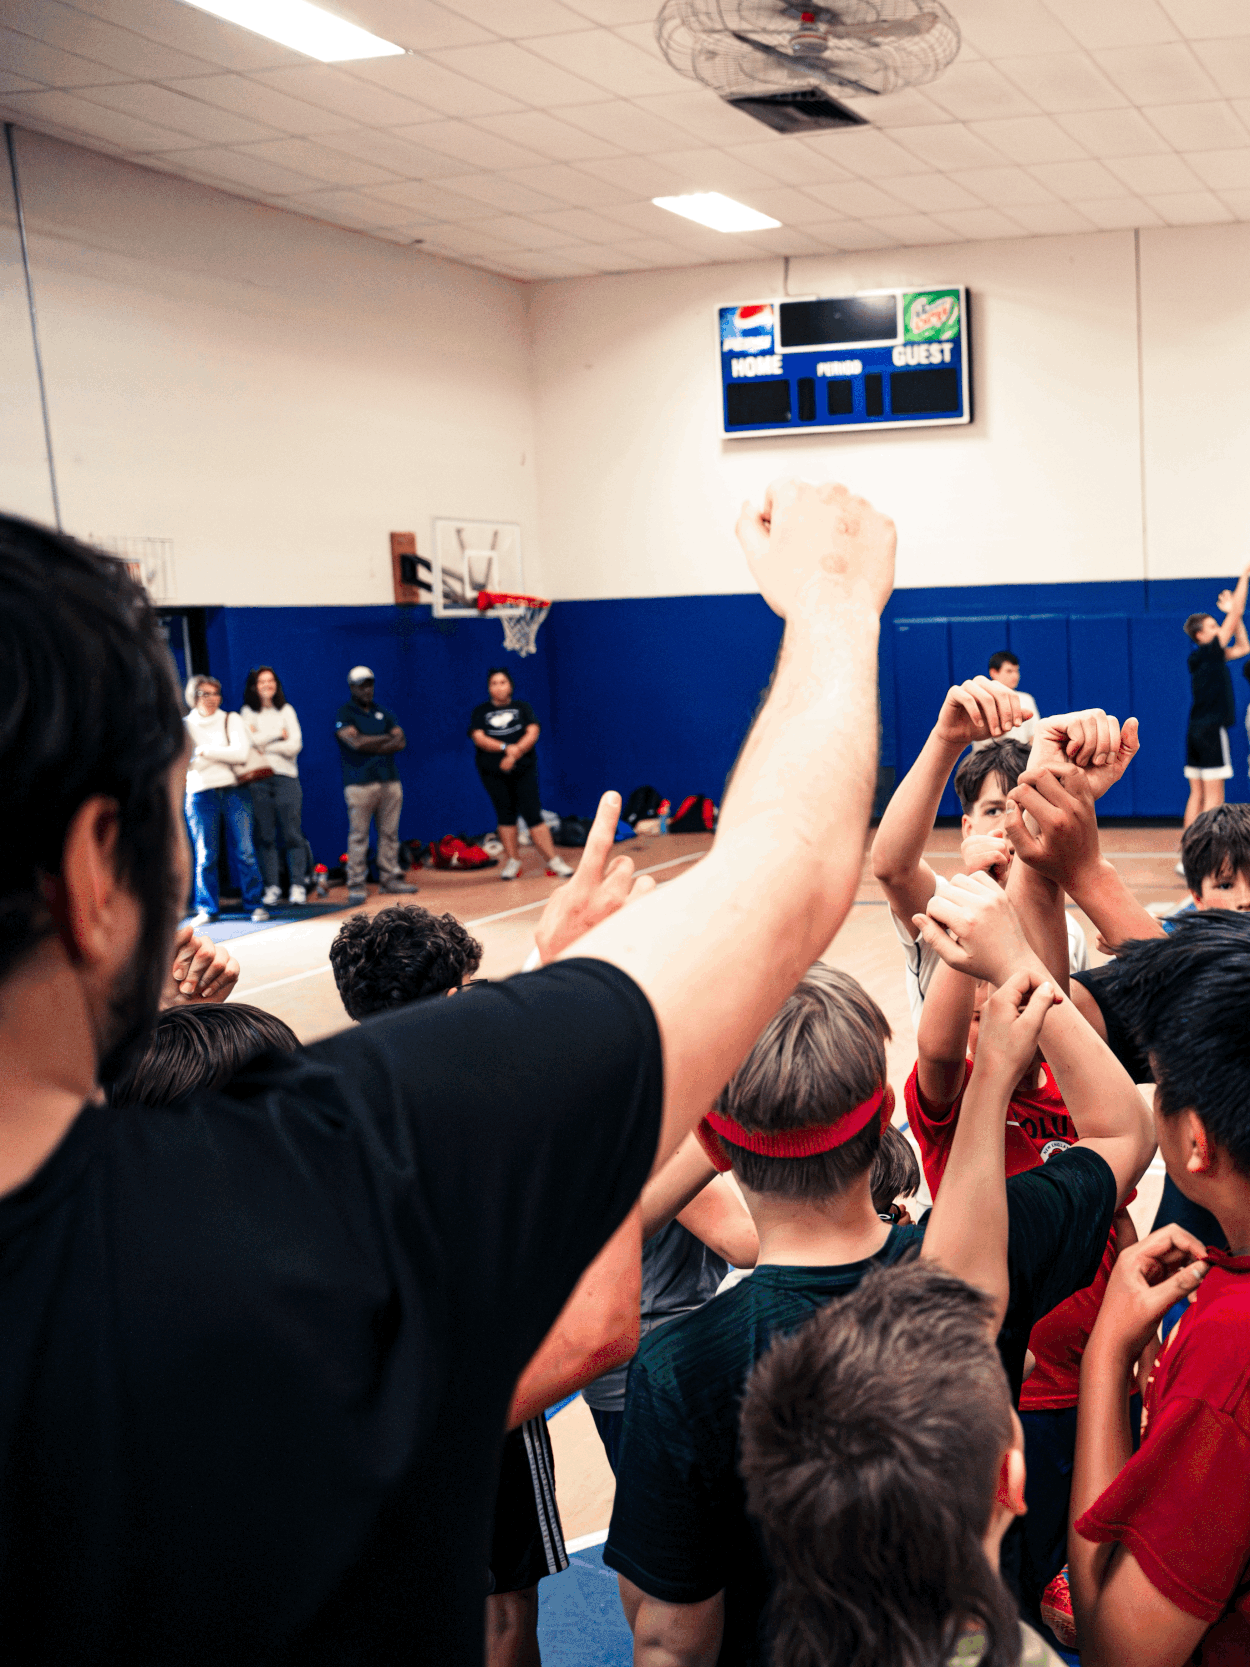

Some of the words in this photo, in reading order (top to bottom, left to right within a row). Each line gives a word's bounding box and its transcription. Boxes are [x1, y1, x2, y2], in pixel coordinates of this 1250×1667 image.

[892, 342, 953, 366] GUEST
[731, 355, 783, 378] HOME
[1019, 1115, 1078, 1139] OLU
